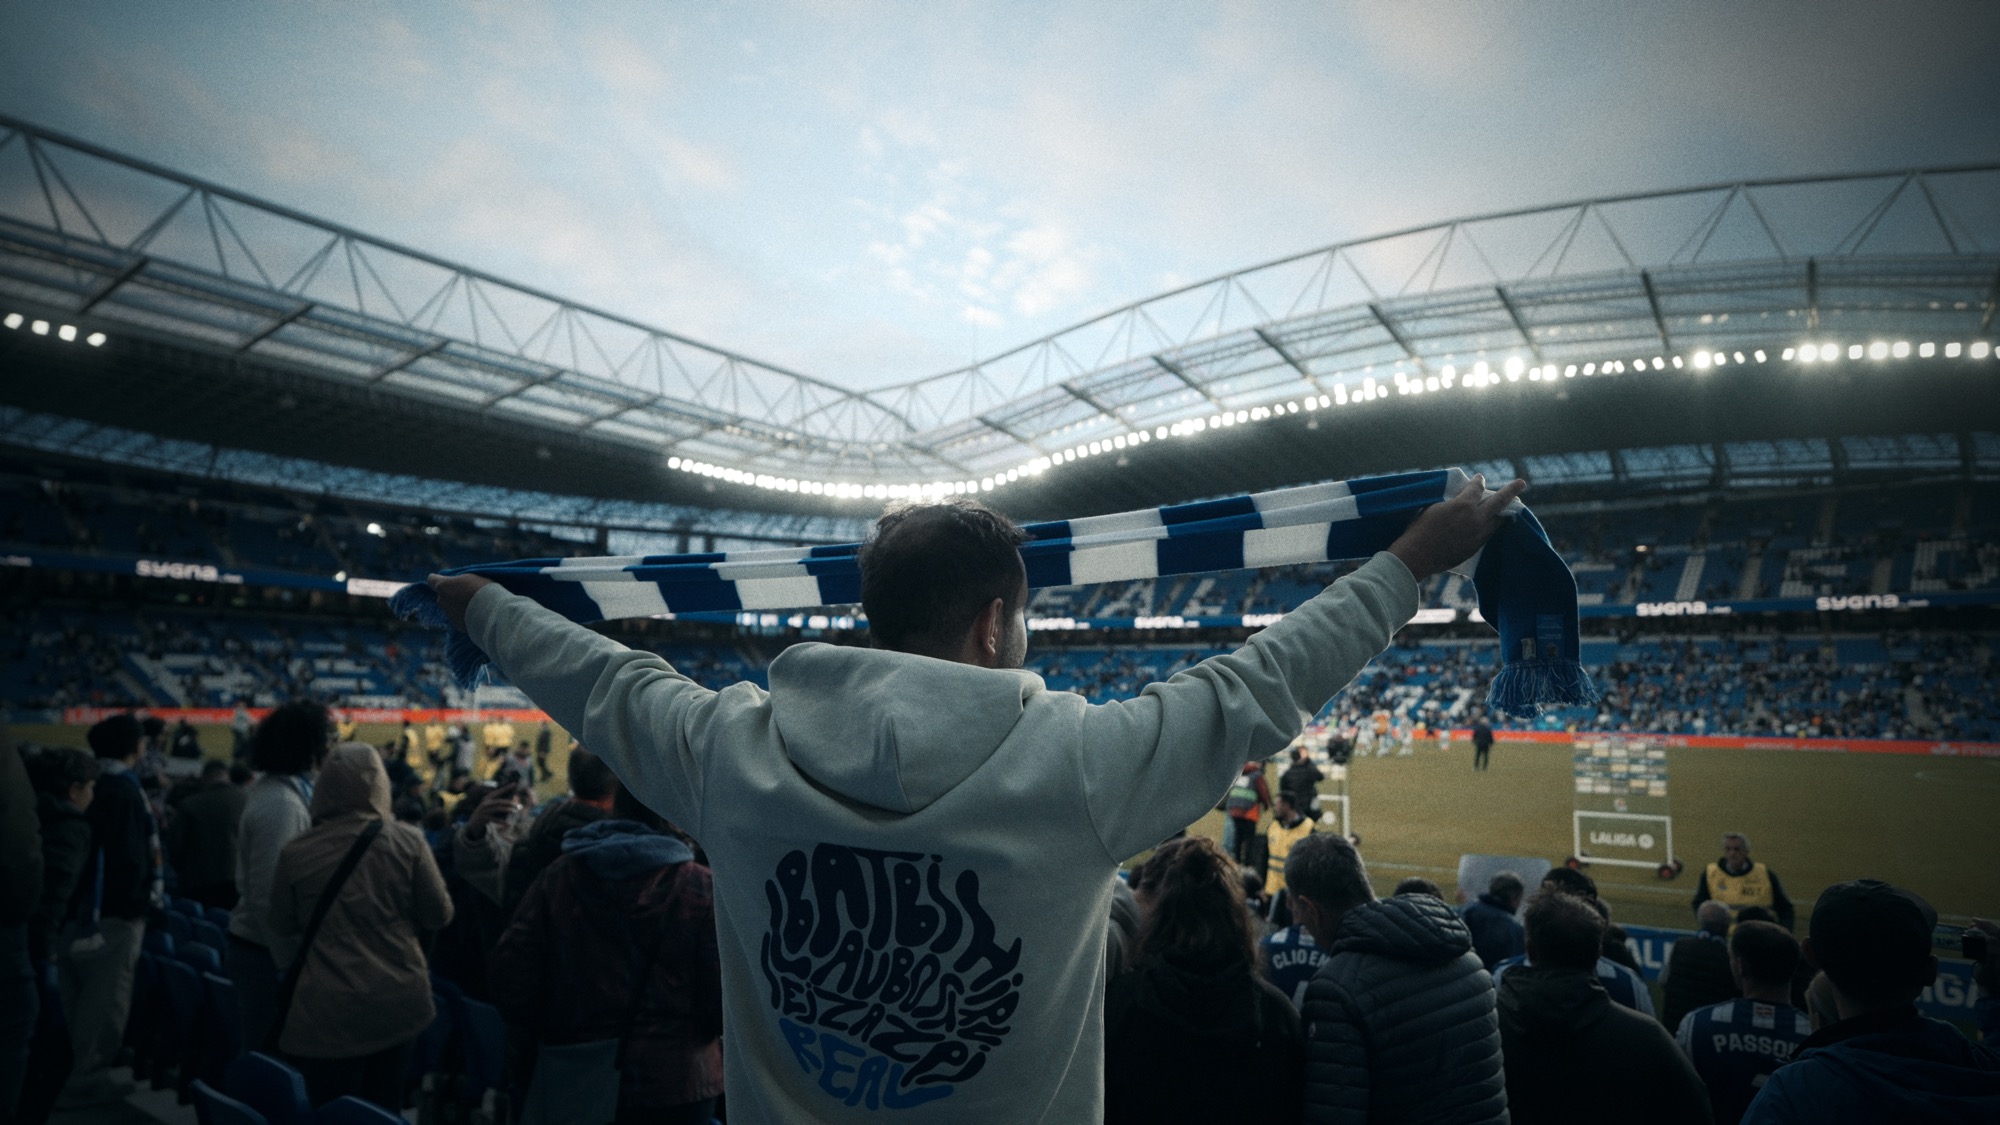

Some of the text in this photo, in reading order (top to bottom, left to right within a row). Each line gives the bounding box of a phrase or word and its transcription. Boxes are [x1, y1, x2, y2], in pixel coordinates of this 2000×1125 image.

[1636, 600, 1708, 617] sygna
[1816, 593, 1900, 611] sygna
[1590, 831, 1638, 847] LALIGA
[779, 1018, 954, 1111] REAL
